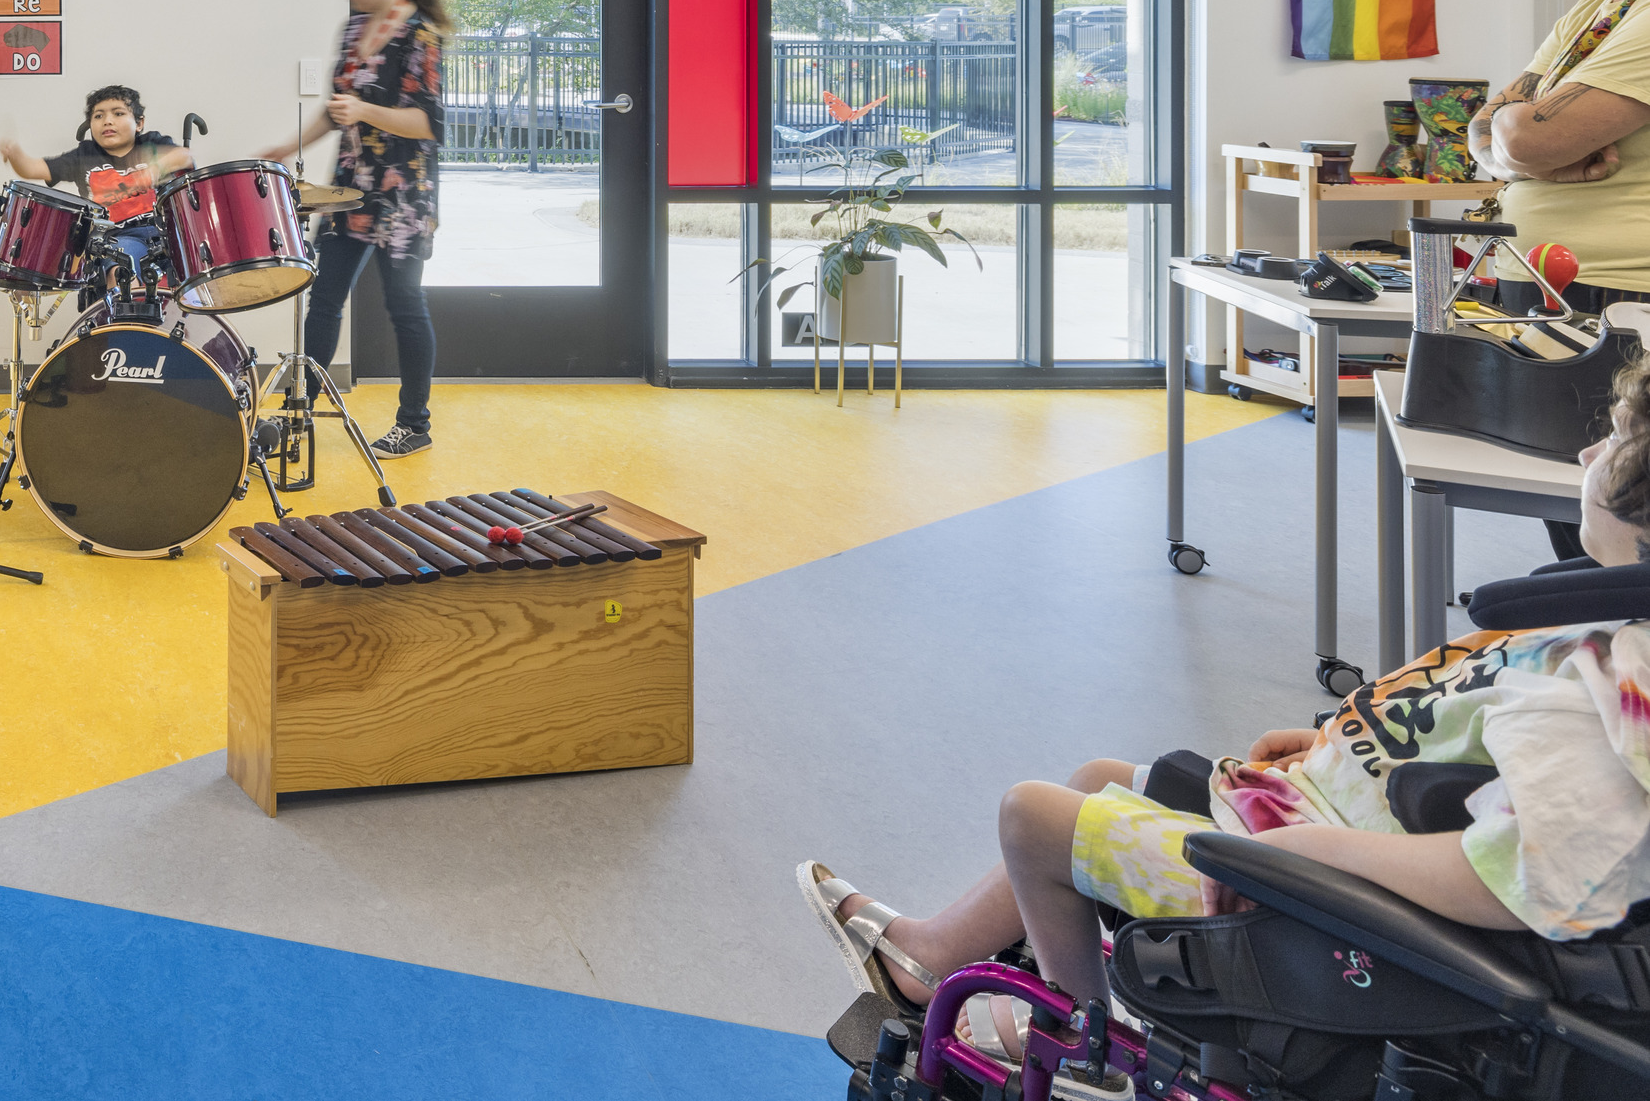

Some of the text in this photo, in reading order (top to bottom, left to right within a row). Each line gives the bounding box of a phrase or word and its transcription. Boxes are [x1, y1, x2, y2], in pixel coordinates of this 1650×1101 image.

[12, 52, 42, 71] DO
[91, 347, 167, 381] Pearl
[1349, 950, 1374, 969] fit
